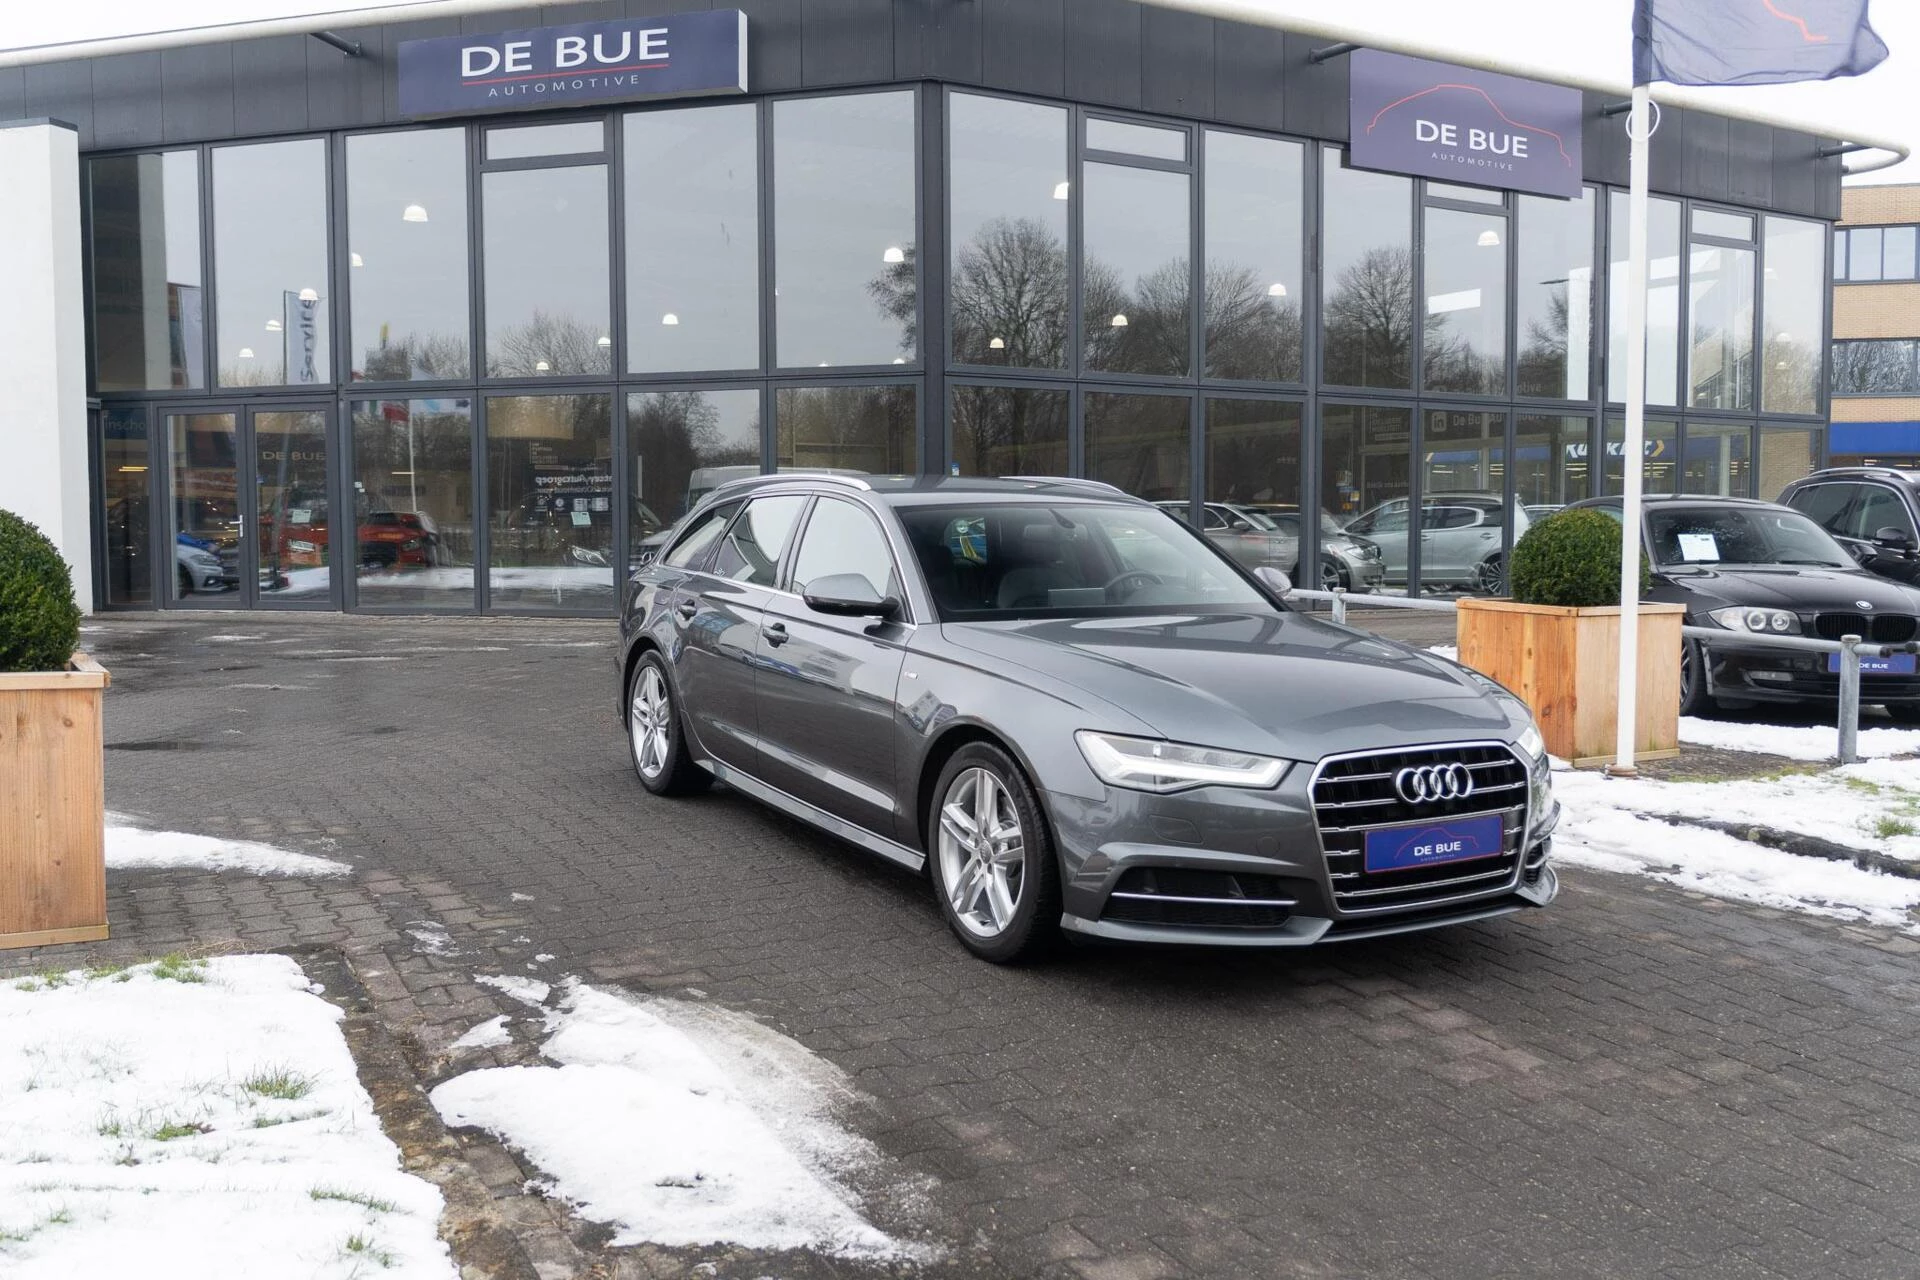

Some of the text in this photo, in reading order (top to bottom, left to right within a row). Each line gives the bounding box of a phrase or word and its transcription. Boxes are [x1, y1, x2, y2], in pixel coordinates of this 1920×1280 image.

[461, 28, 670, 77] DE BUE
[488, 75, 640, 97] AUTOMOTIVE
[1416, 119, 1528, 158] DE BUE
[1432, 152, 1513, 171] AUTOMOTIVE
[263, 451, 327, 461] DE BUE
[1414, 841, 1461, 856] DE BUE
